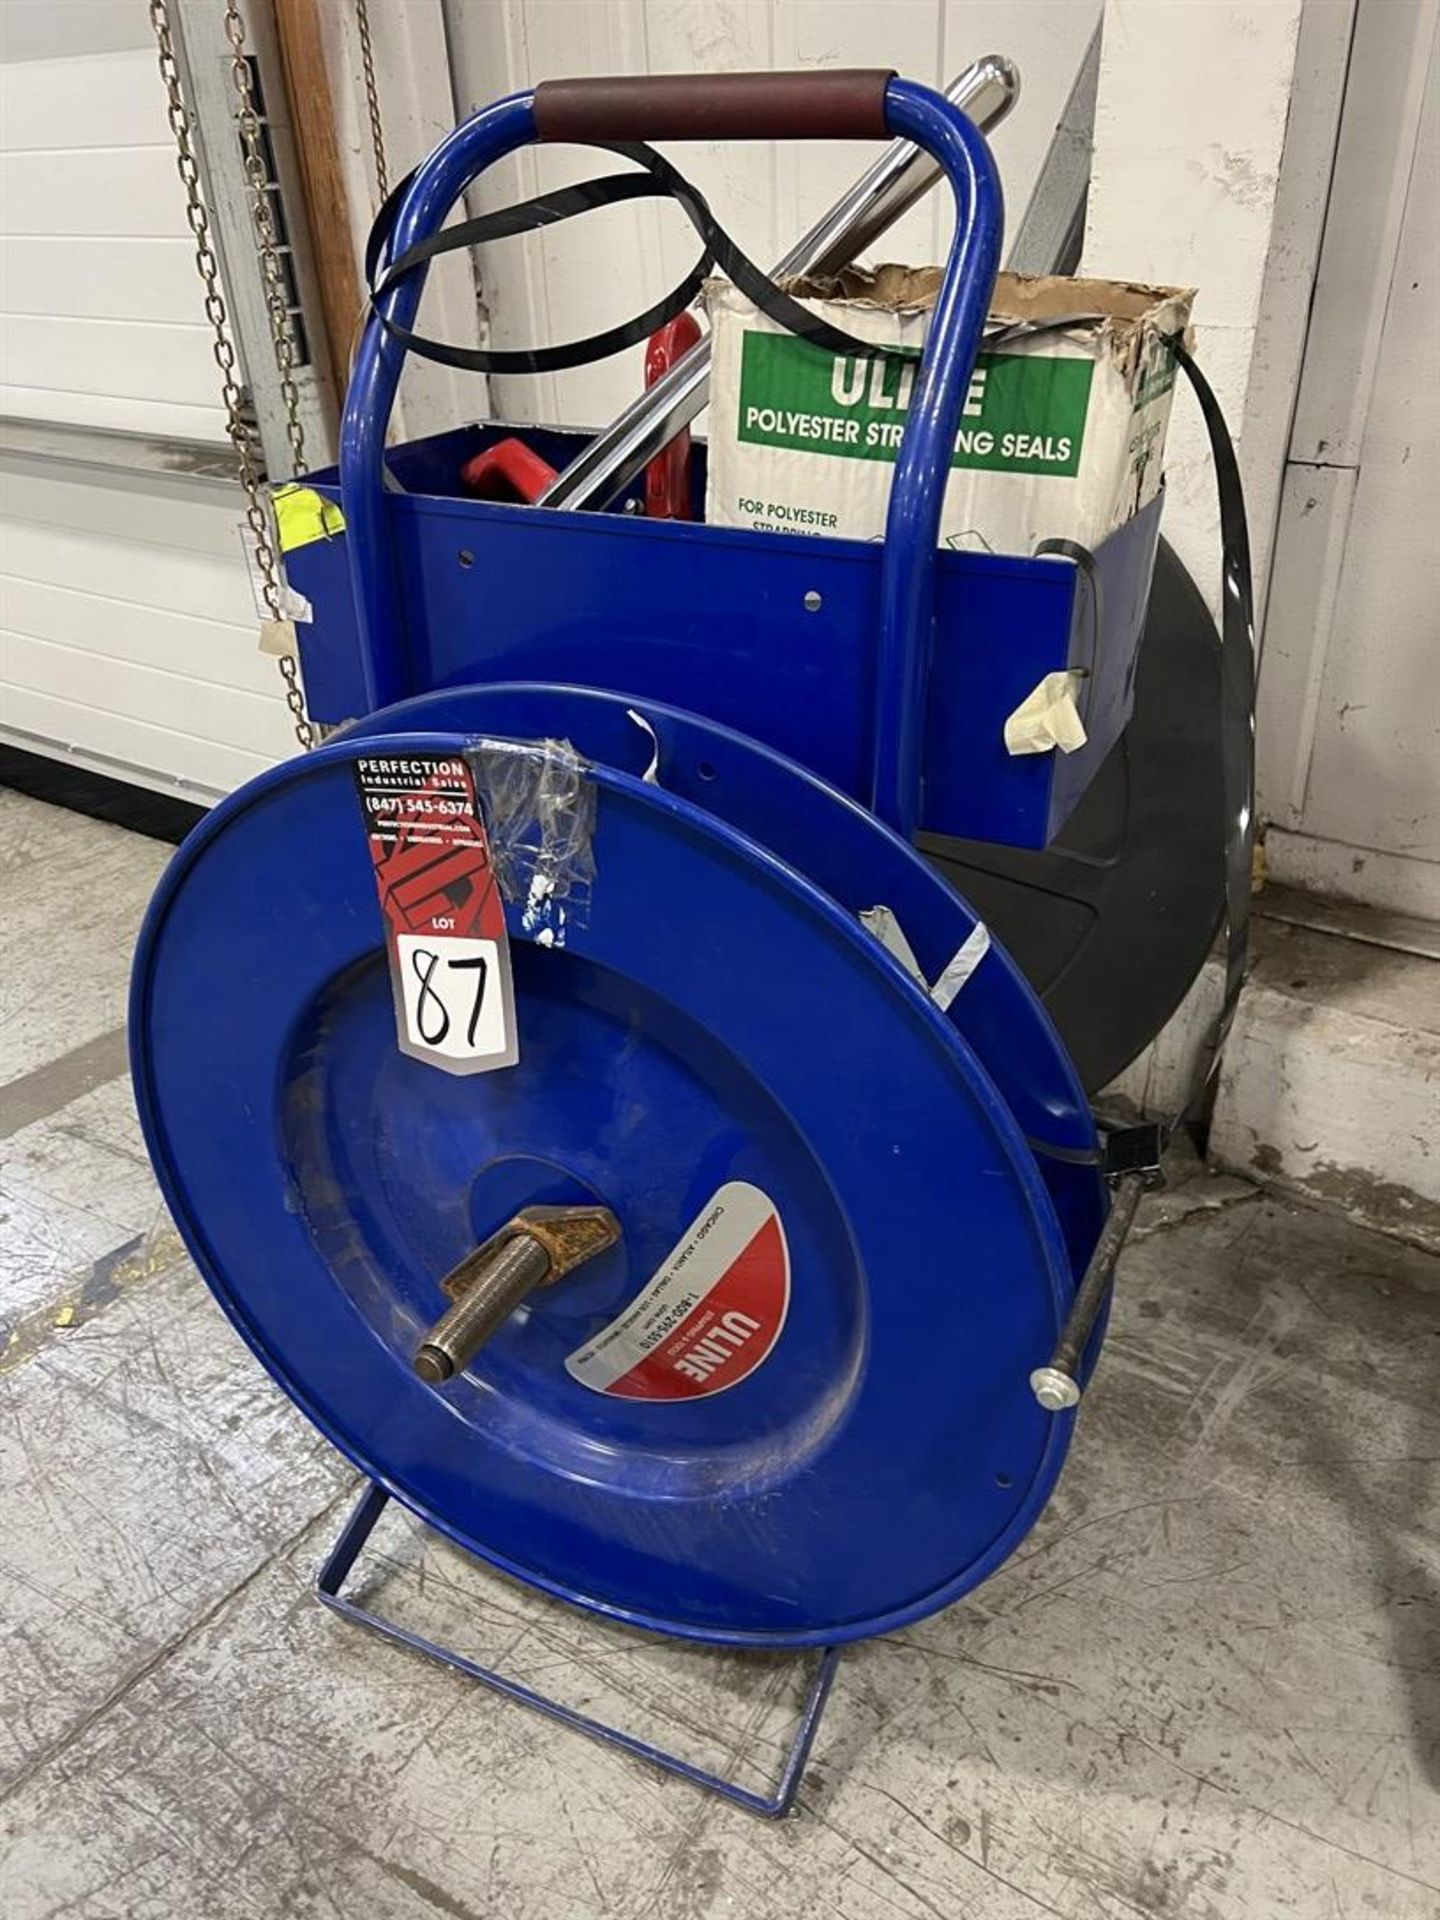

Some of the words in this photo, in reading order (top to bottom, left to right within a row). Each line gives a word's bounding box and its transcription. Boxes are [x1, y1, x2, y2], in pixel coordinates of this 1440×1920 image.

[831, 356, 987, 416] ULIE
[746, 408, 859, 443] POLYESTER
[866, 423, 994, 454] STRNG
[1001, 434, 1071, 461] SEALS
[738, 497, 764, 515] FOR
[767, 503, 838, 529] POLYESTER
[358, 759, 465, 776] PERFECTION
[361, 774, 426, 787] Industrial
[431, 777, 467, 789] Sales
[366, 796, 404, 814] (847)
[407, 799, 474, 817] 545-6374
[432, 916, 455, 930] LOT
[412, 948, 488, 1048] 87
[697, 1206, 724, 1239] CHICAGO
[672, 1244, 695, 1271] ATLANTA
[673, 1311, 761, 1382] ULINE
